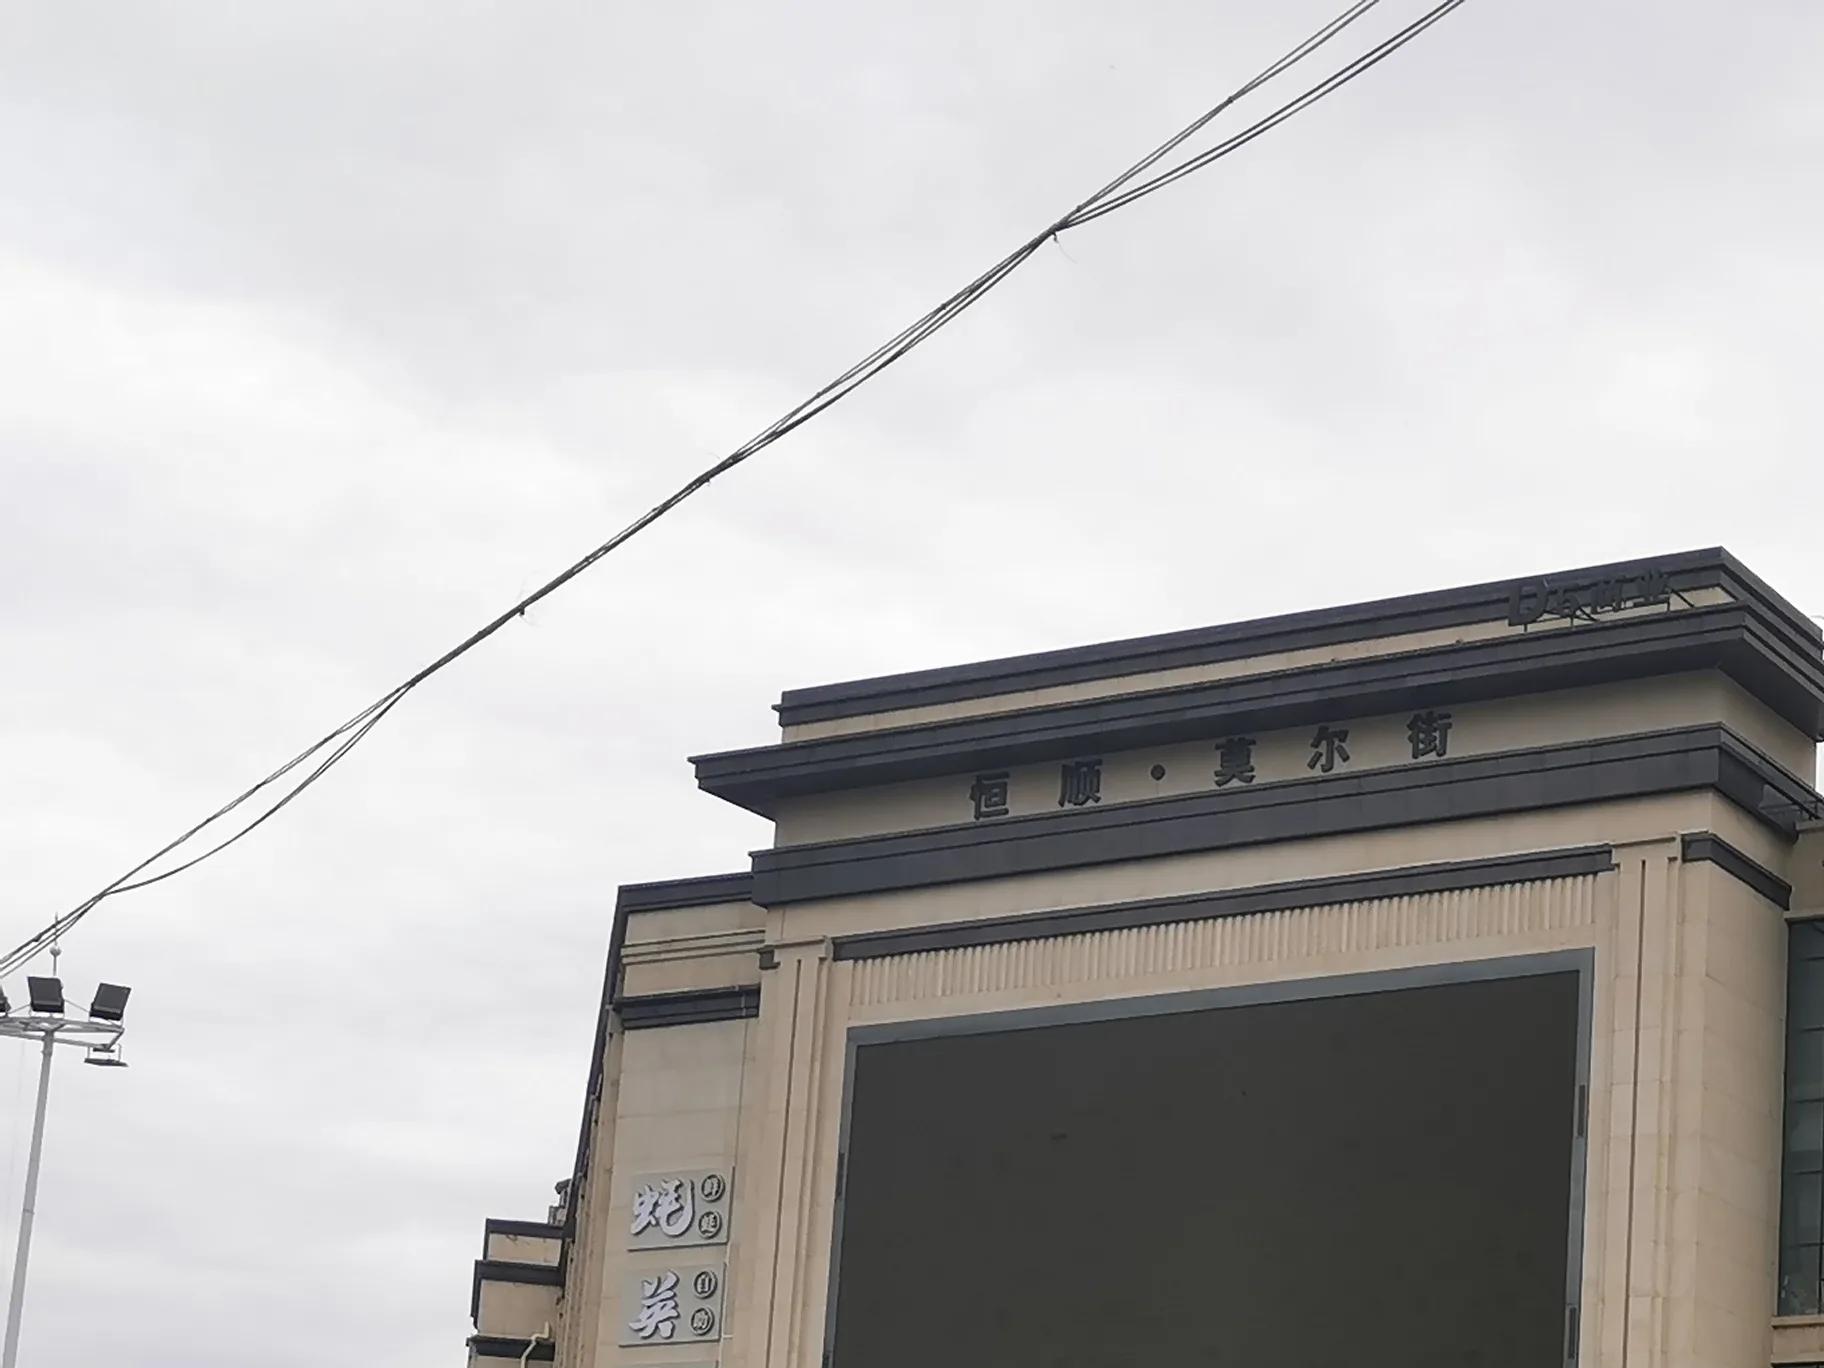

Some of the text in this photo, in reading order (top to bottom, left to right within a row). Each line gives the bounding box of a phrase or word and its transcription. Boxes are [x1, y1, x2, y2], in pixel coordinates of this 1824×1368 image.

[969, 709, 1453, 821] 恒顺·莫尔街
